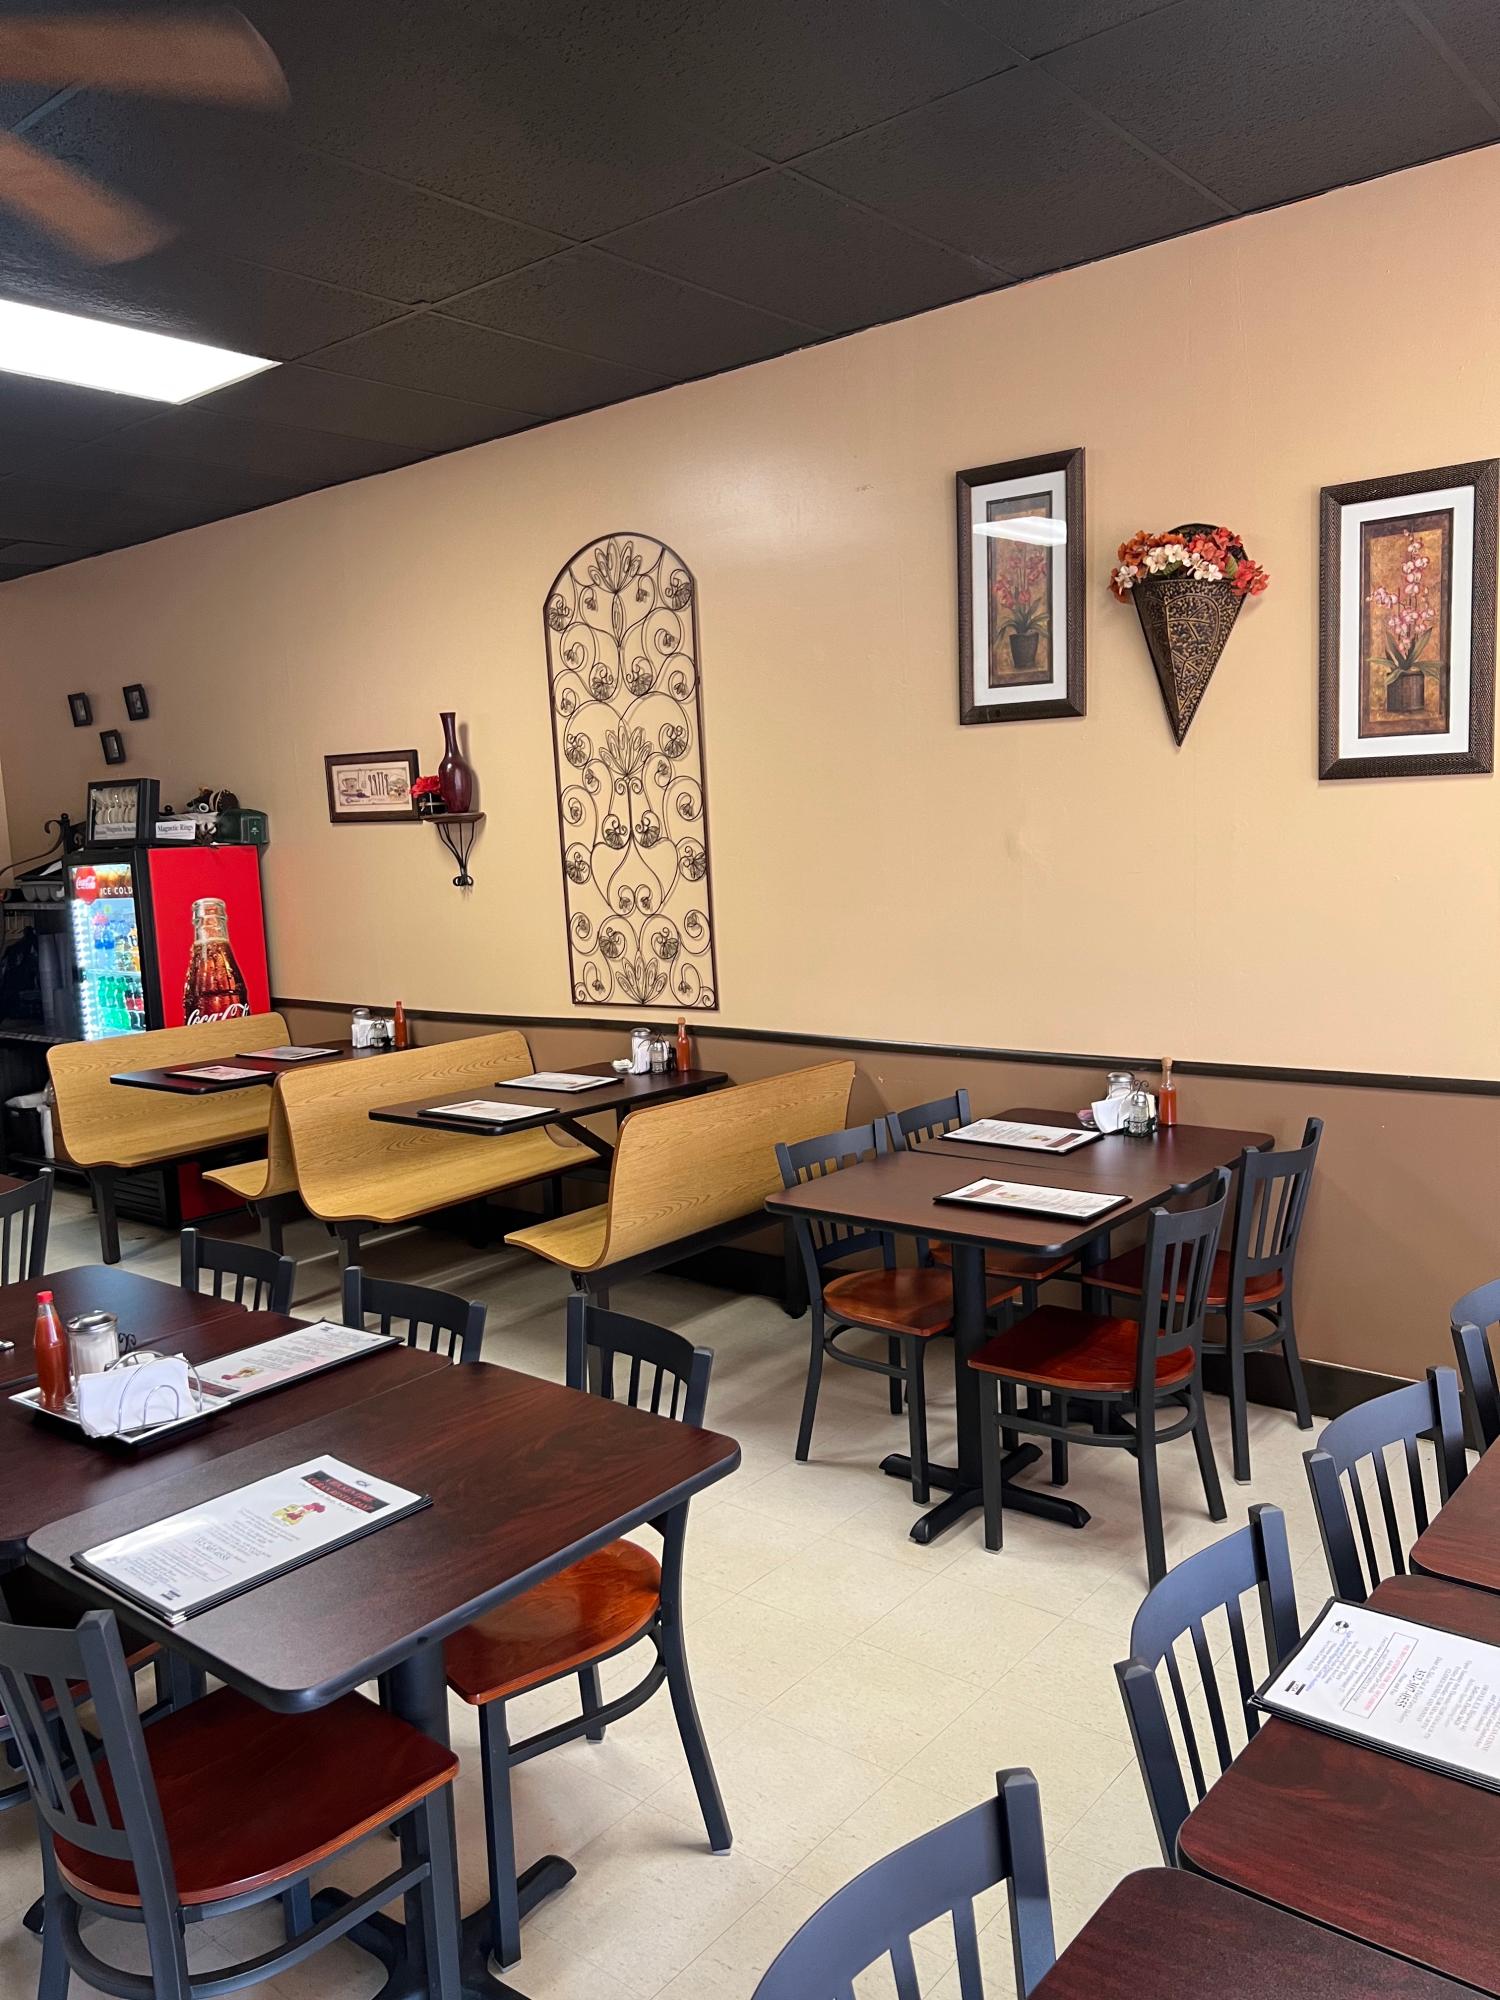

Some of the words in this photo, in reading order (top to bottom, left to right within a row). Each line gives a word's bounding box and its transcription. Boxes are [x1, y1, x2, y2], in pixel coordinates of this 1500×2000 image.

[100, 887, 112, 895] ICE
[114, 887, 133, 895] COLD
[187, 1003, 250, 1026] Coca-Cl
